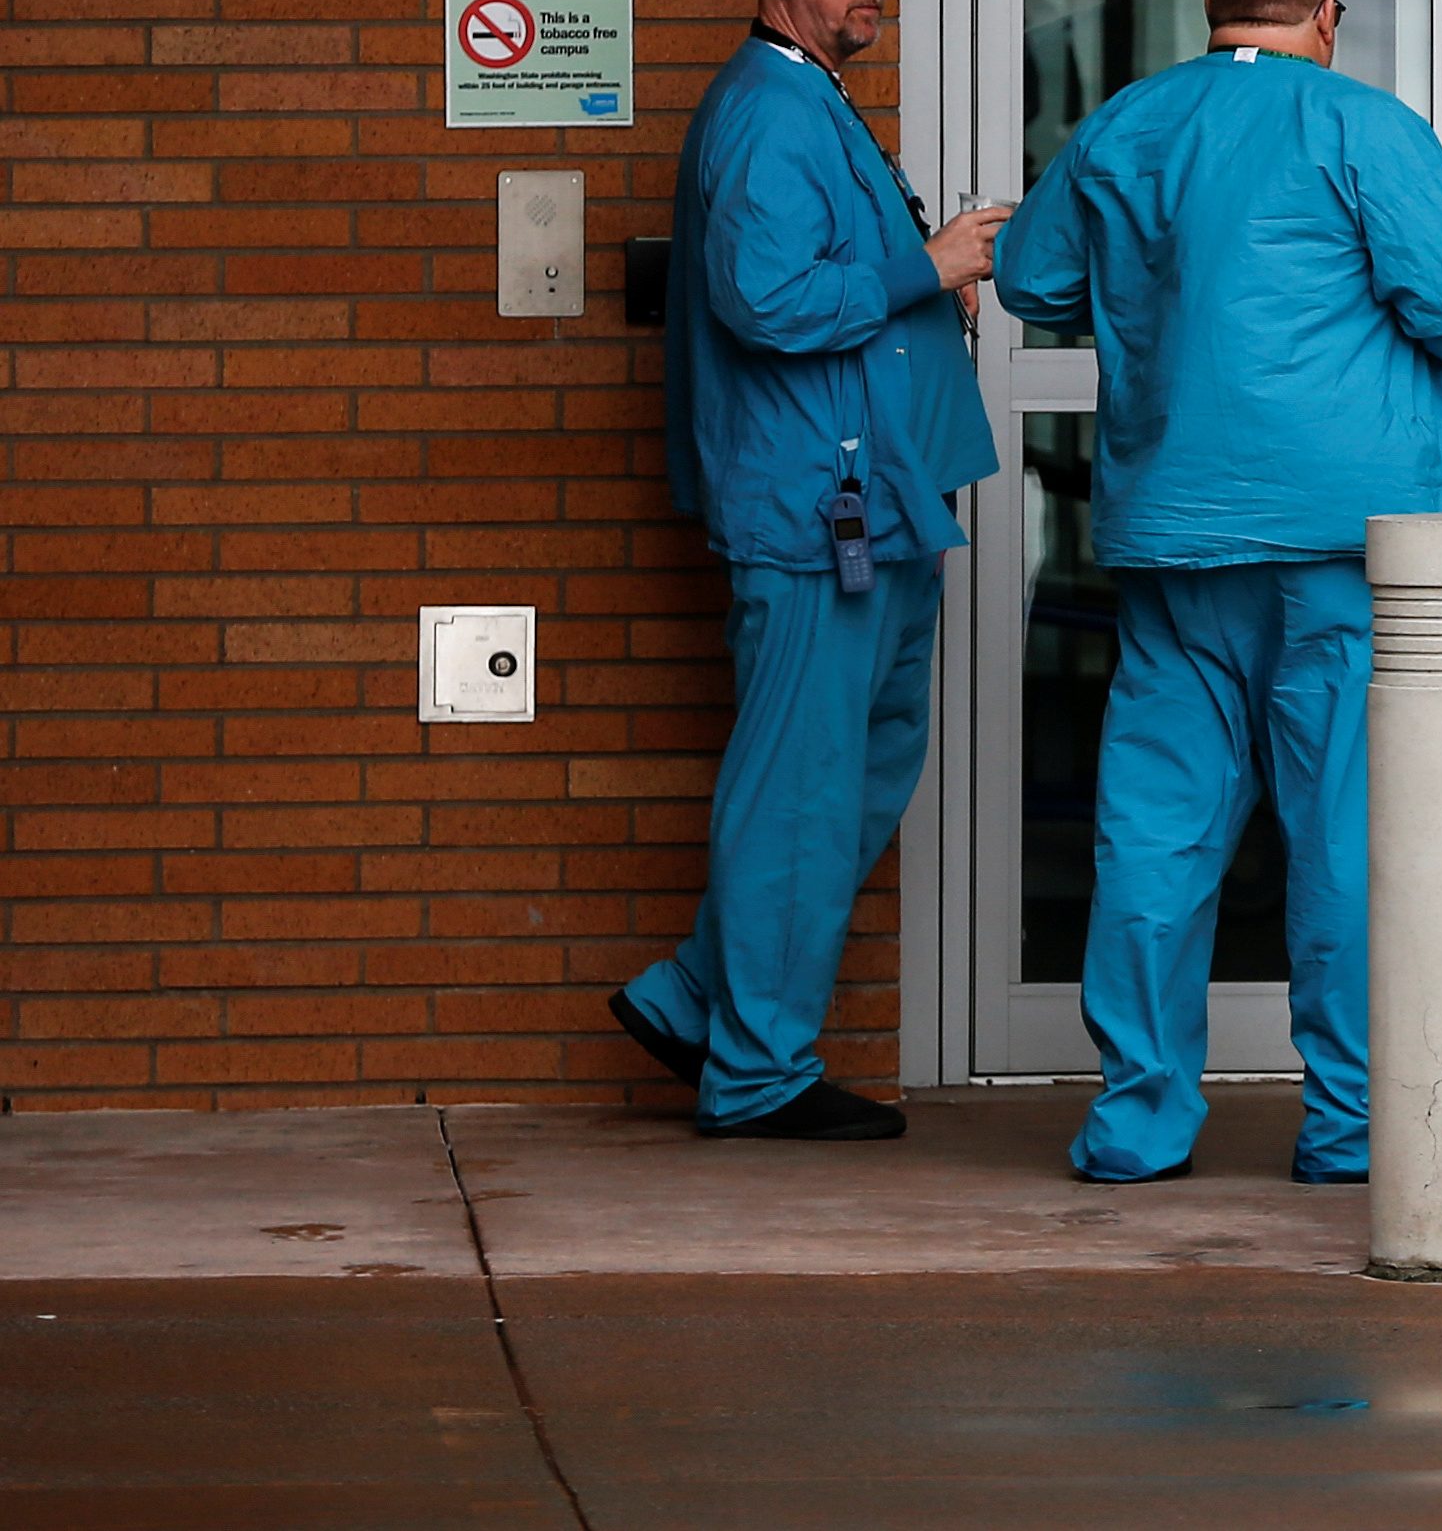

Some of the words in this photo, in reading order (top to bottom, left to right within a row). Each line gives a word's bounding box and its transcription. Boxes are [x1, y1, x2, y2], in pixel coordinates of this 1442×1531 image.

[541, 12, 565, 24] This
[568, 12, 579, 24] is
[582, 14, 590, 24] a
[541, 27, 590, 39] tobacco
[593, 26, 618, 39] free
[541, 45, 589, 57] campus
